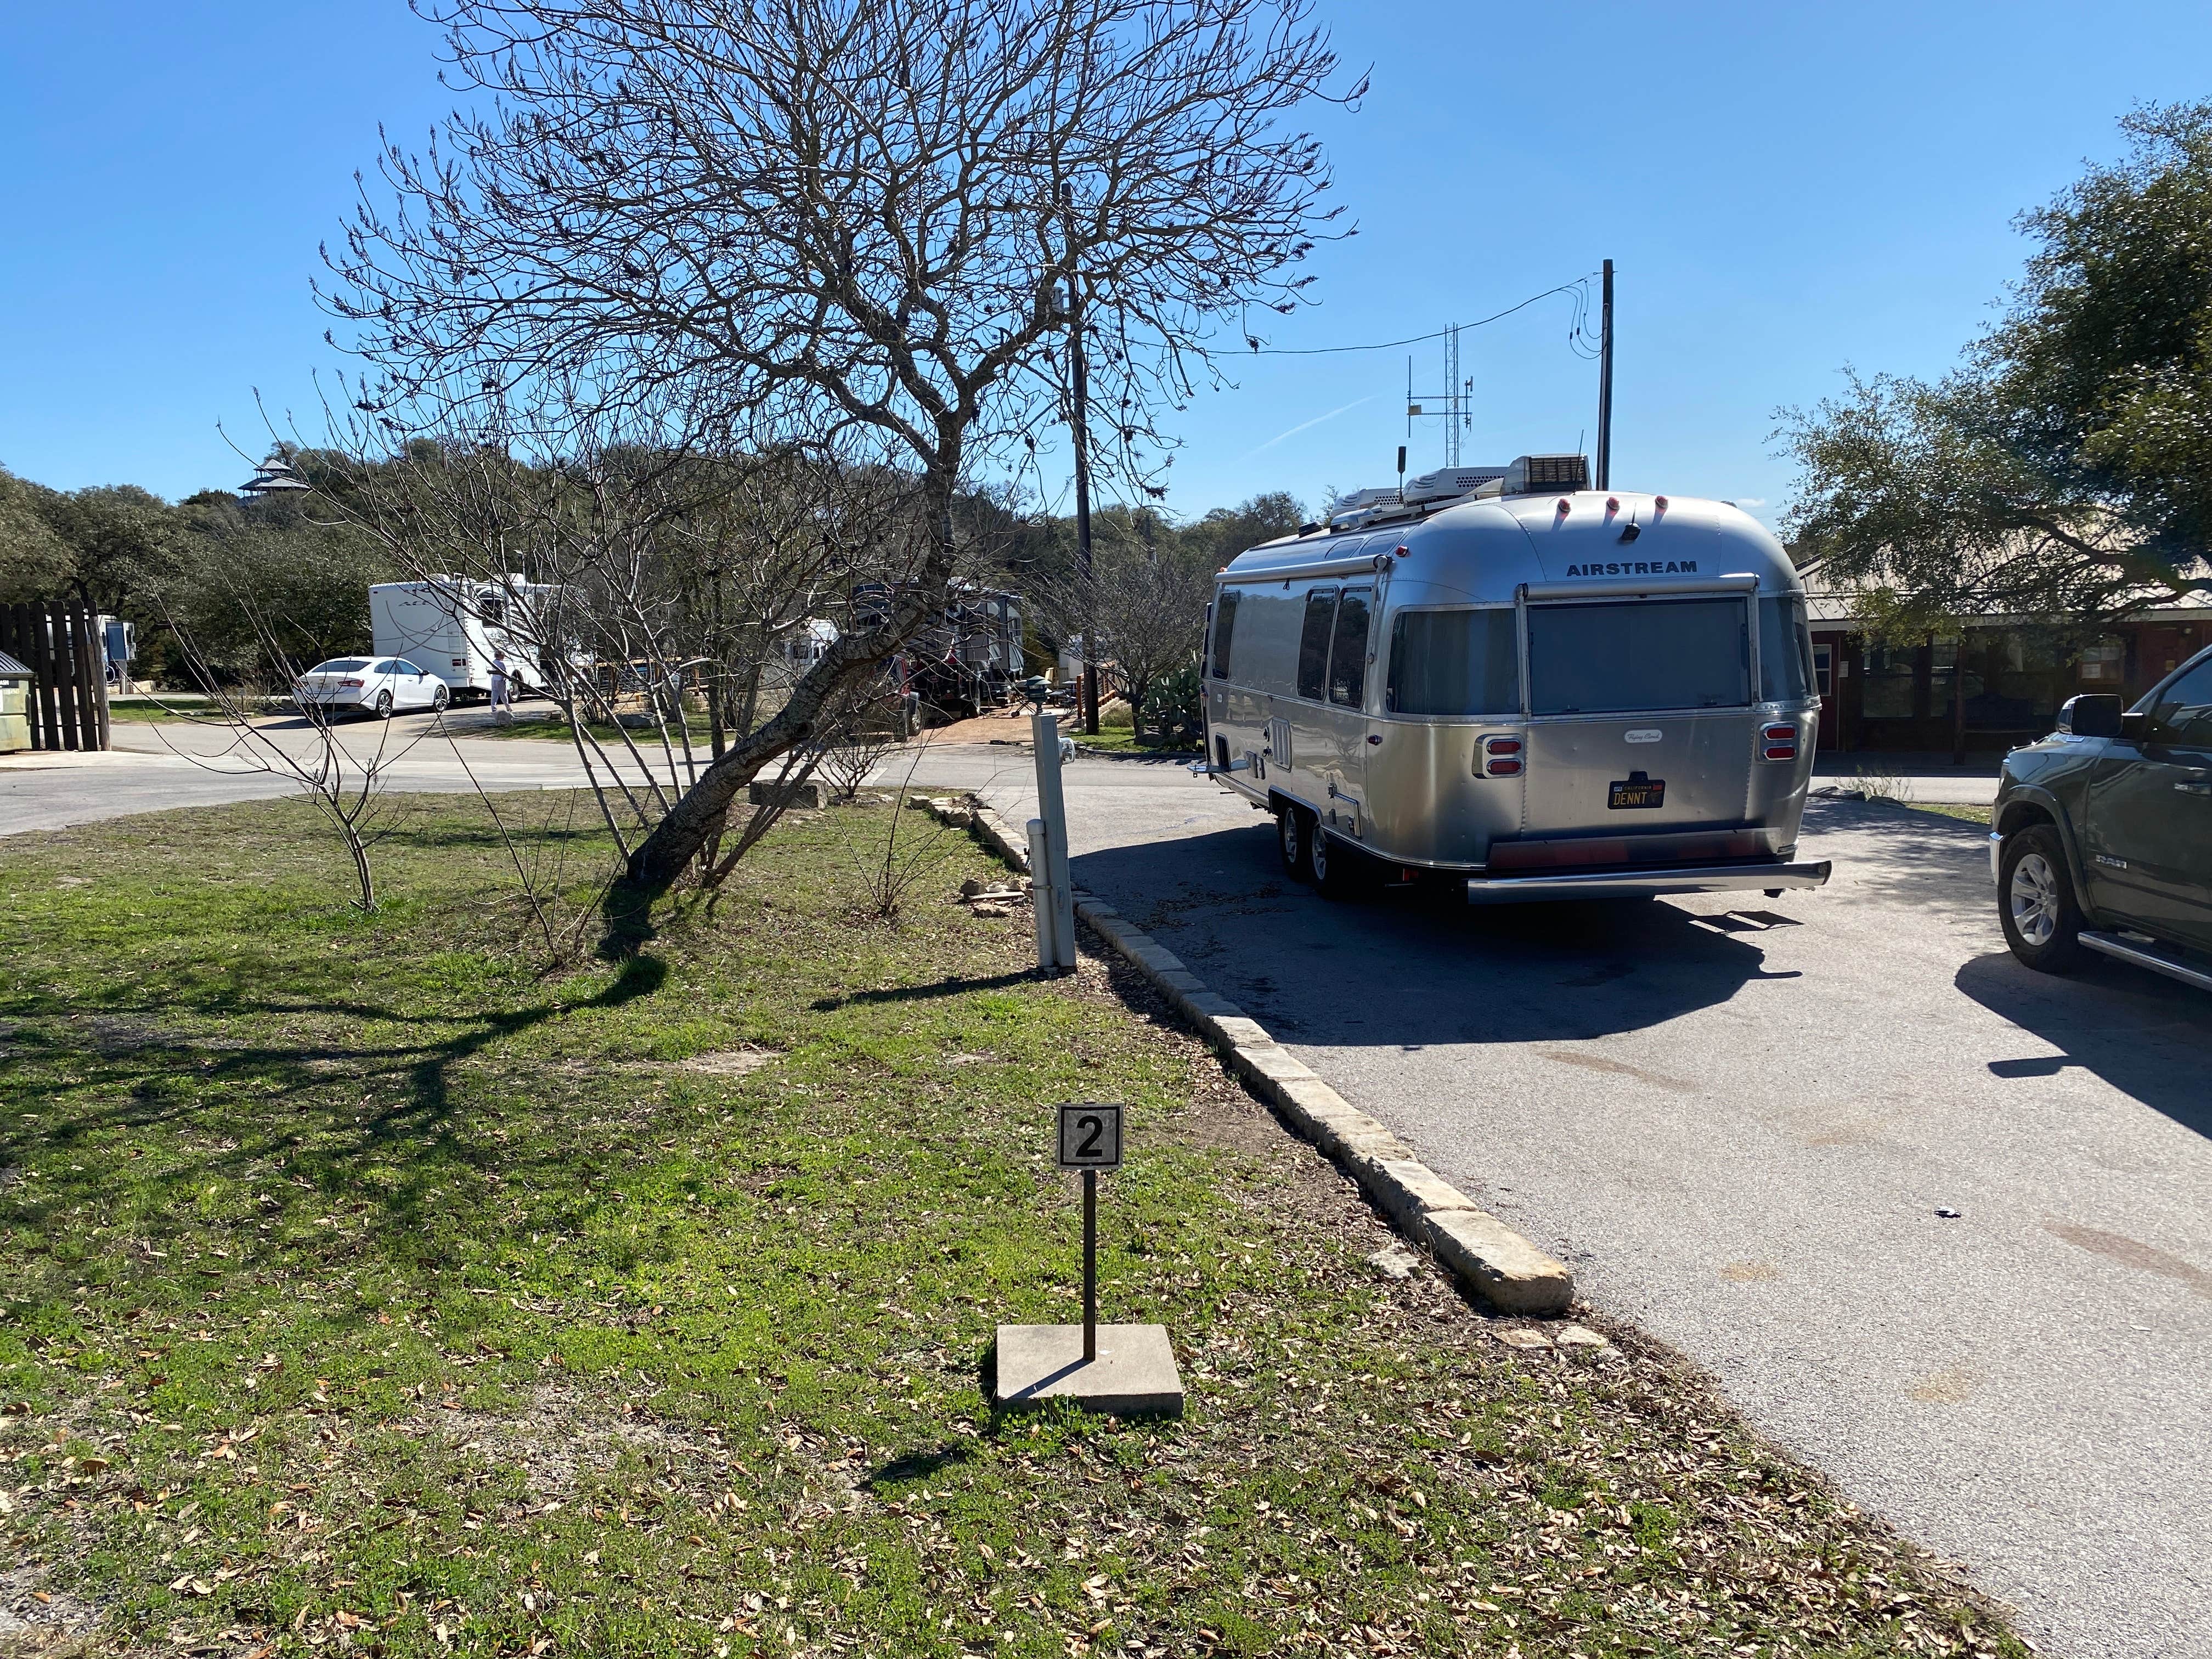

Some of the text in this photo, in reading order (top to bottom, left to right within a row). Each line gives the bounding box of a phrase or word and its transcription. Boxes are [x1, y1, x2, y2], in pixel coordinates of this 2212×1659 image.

[1566, 561, 1697, 576] AIRSTREAM
[1613, 792, 1647, 805] DENNT
[2096, 855, 2127, 869] RAM
[1075, 1115, 1103, 1157] 2
